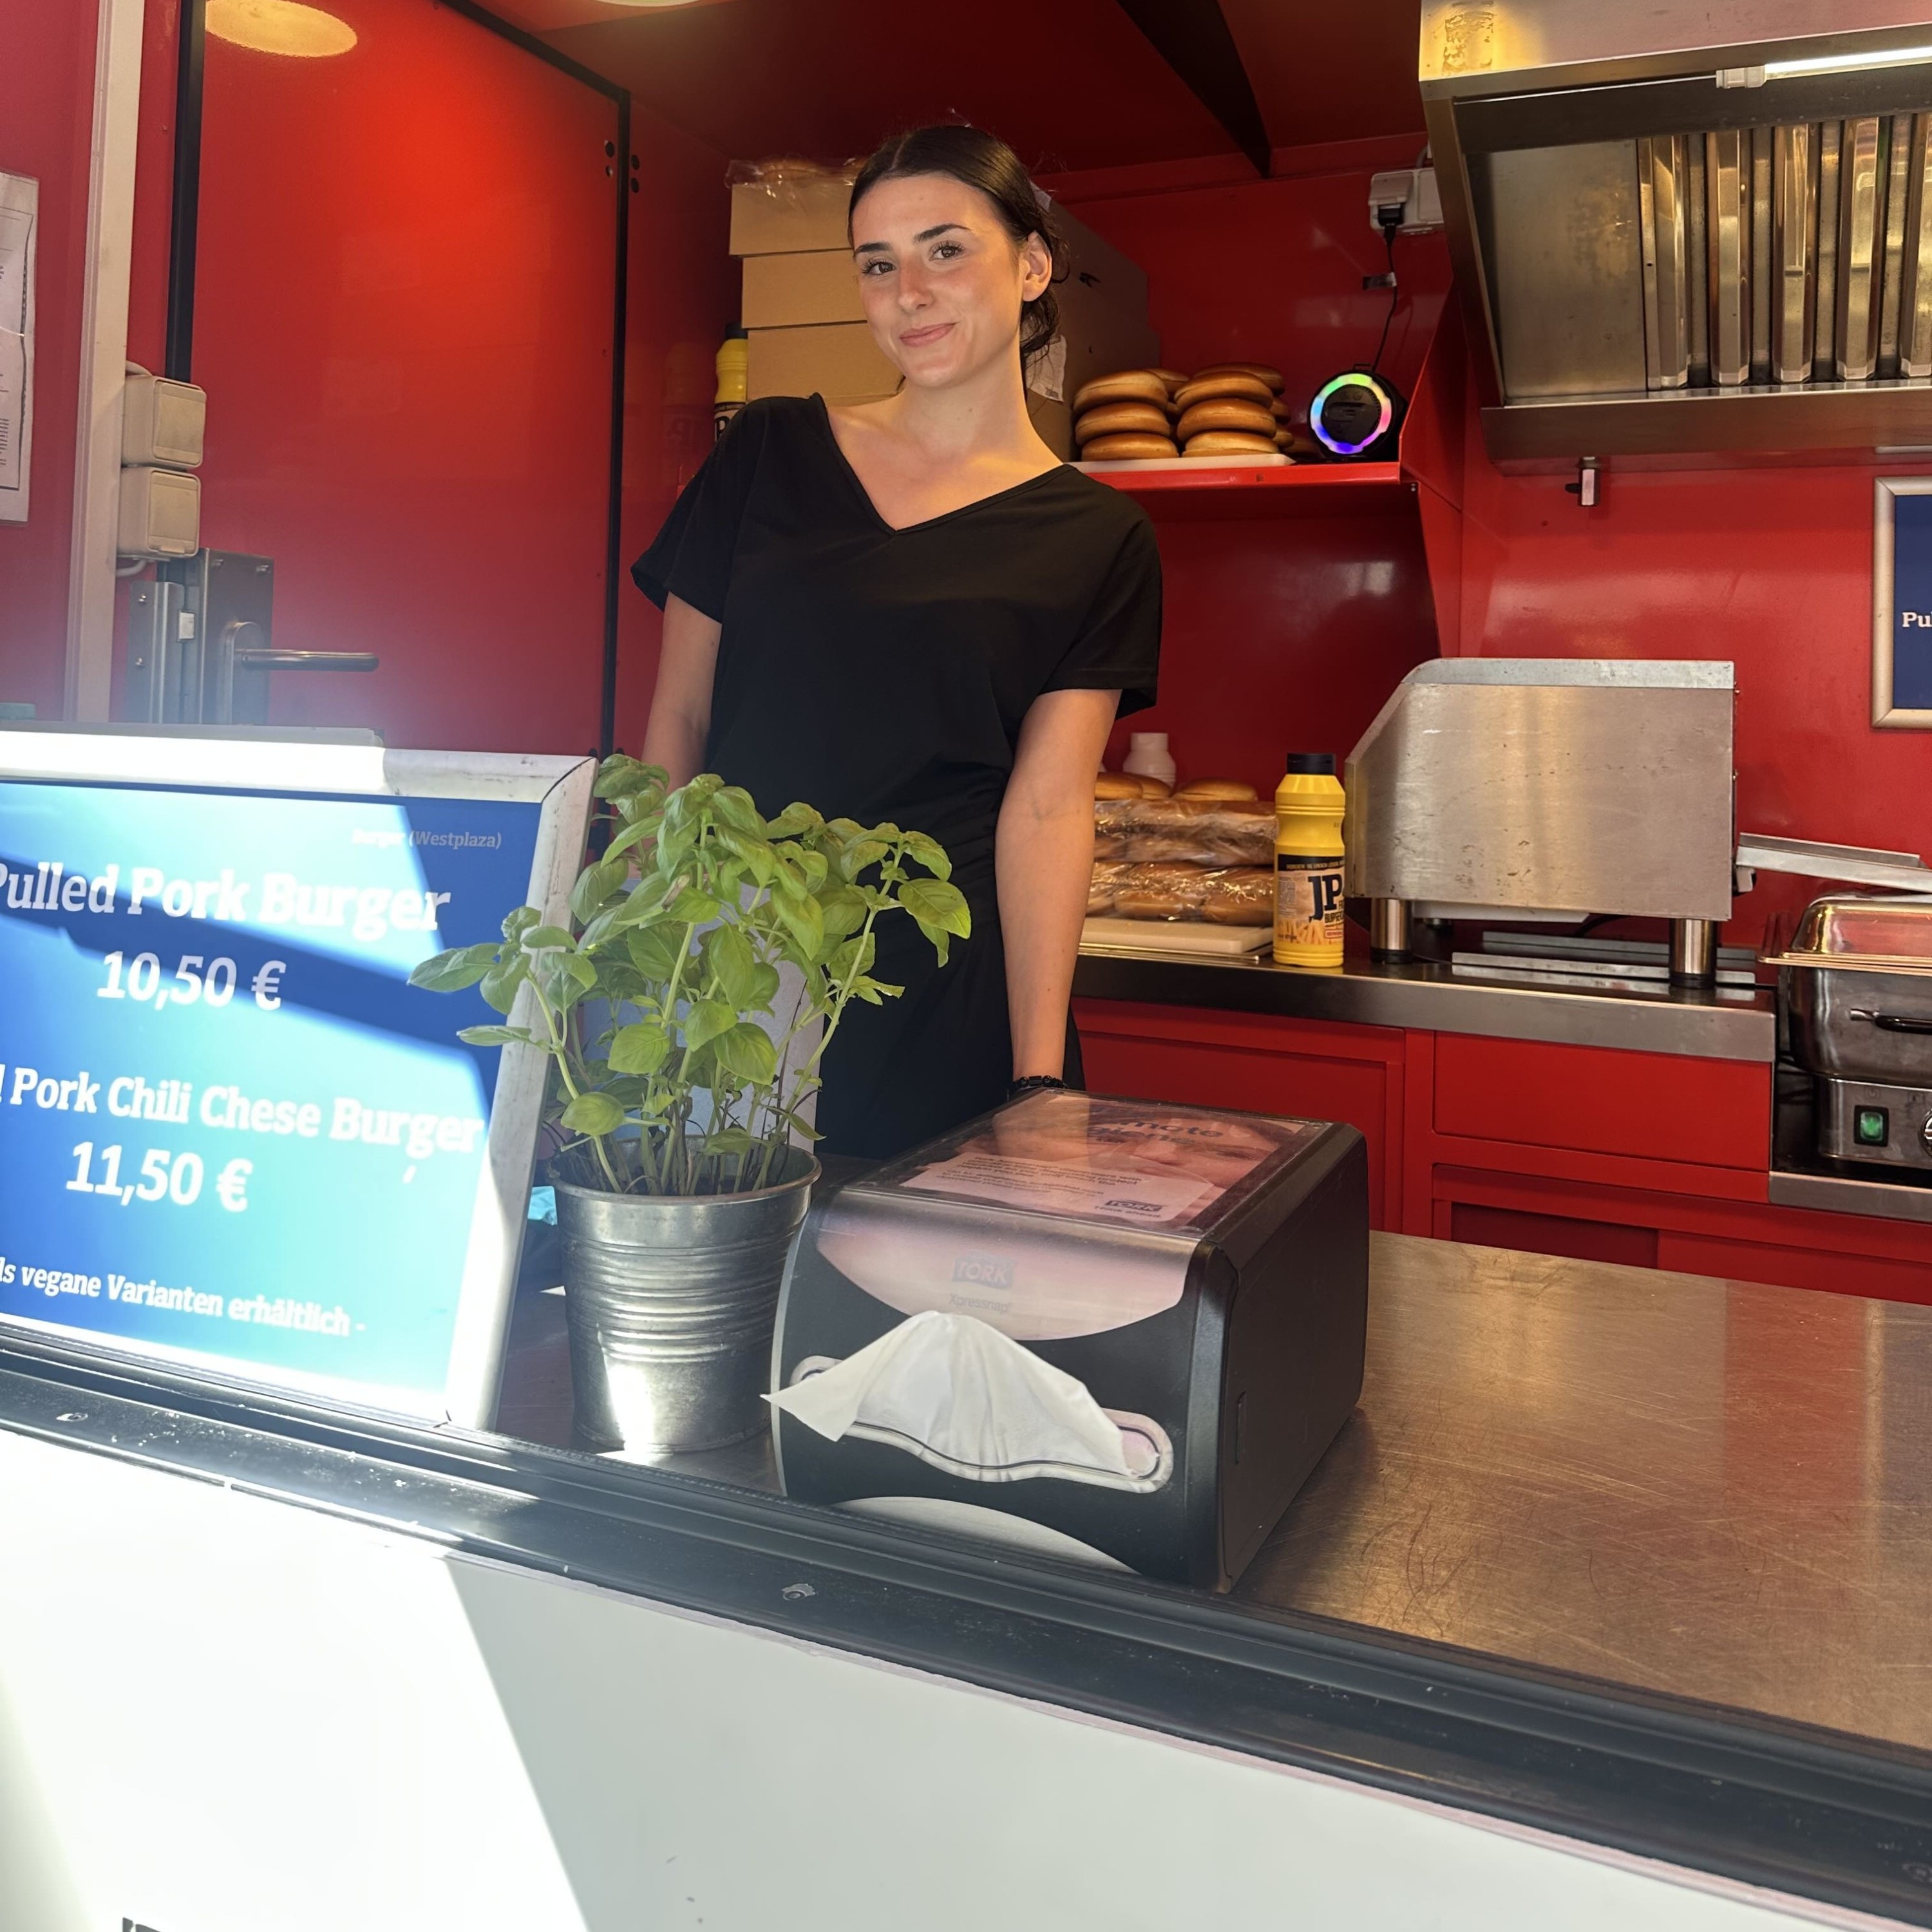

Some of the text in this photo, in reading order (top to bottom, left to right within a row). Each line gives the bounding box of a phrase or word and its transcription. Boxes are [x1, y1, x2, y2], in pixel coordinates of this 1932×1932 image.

[1902, 611, 1932, 628] Pu
[409, 830, 502, 849] (Westplaza)
[127, 866, 251, 922] Pork
[259, 871, 451, 942] Burger
[1308, 874, 1343, 923] JP
[97, 951, 287, 1011] 10,50 €
[10, 1066, 101, 1114] Pork
[108, 1076, 193, 1124] Chili
[199, 1084, 322, 1138] Chese
[328, 1097, 486, 1159] Burger
[66, 1141, 254, 1212] 11,50 €
[21, 1266, 102, 1297] vegane
[107, 1274, 223, 1317] Varianten
[228, 1294, 352, 1337] erhältlich
[956, 1260, 1010, 1285] TORK
